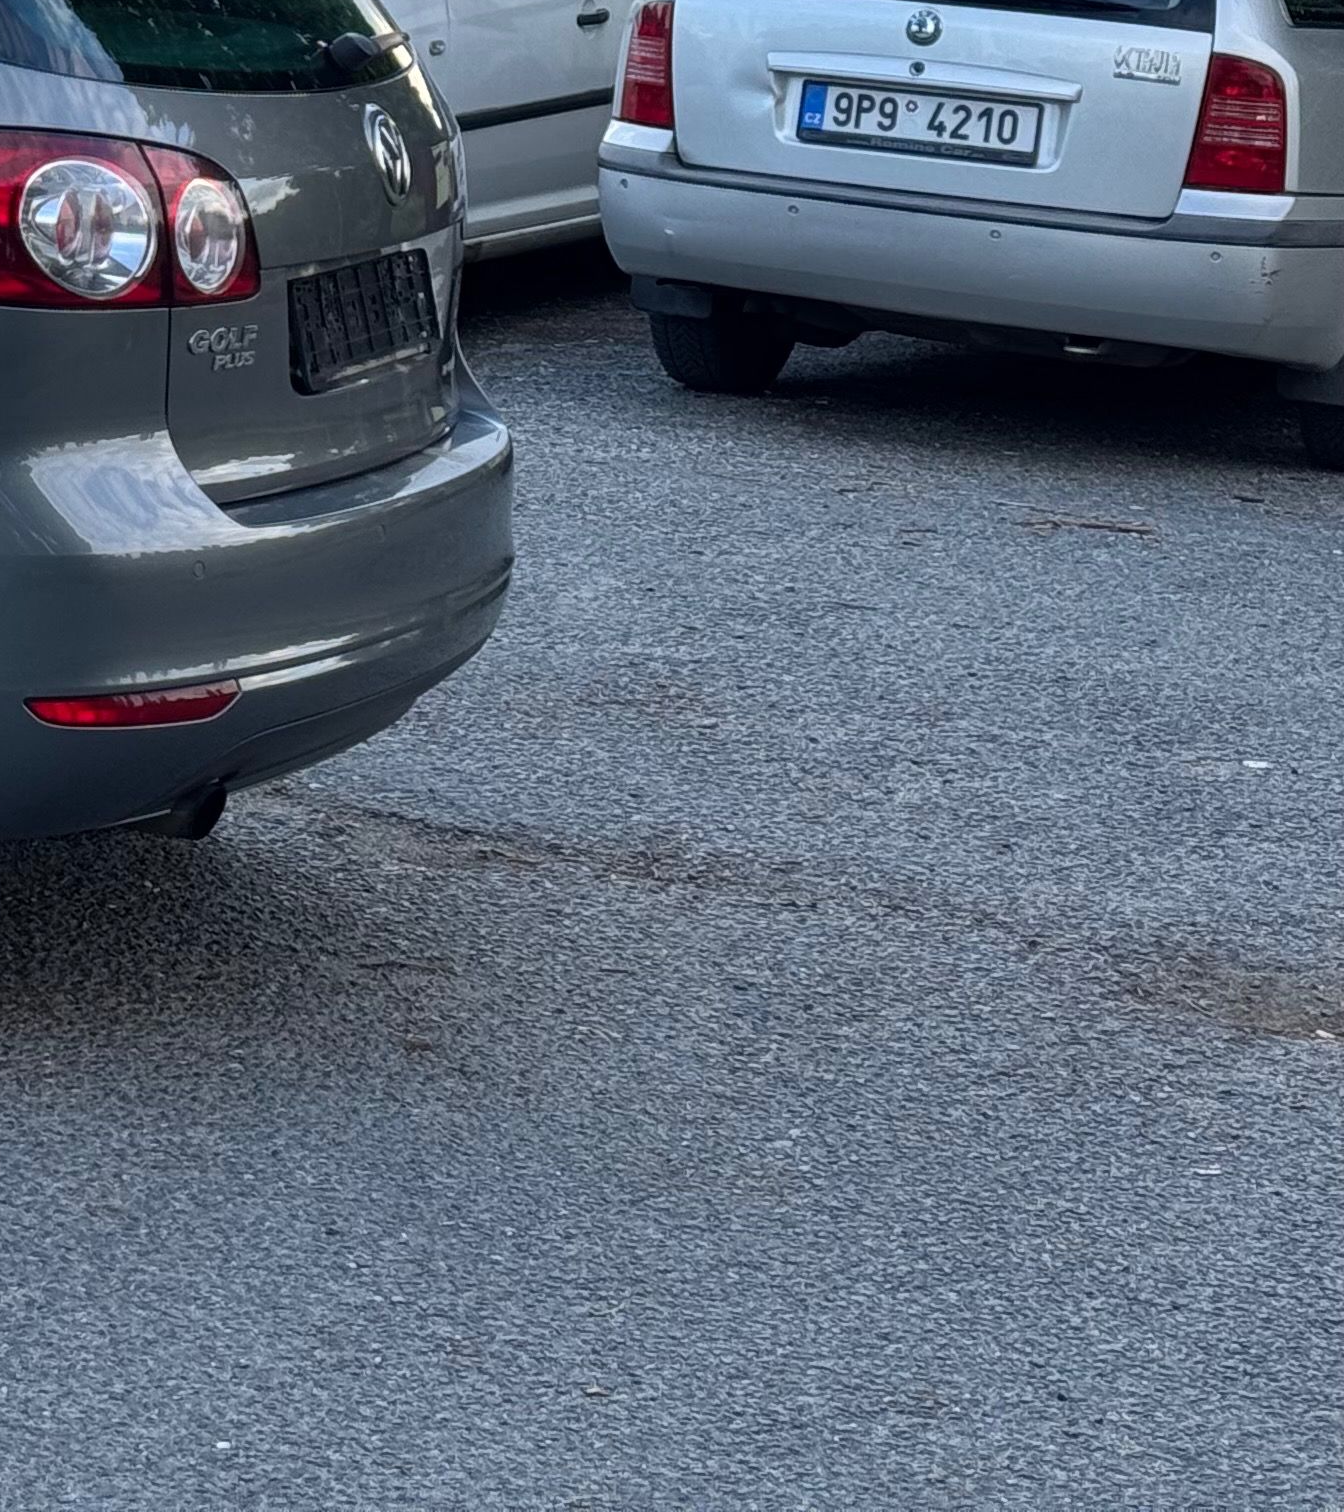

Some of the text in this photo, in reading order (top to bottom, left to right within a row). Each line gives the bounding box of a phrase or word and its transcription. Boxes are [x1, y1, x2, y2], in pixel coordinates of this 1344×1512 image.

[804, 111, 822, 125] CZ
[832, 91, 1020, 145] 9P9 4210
[188, 324, 259, 356] GOLF
[212, 350, 256, 372] PLUS
